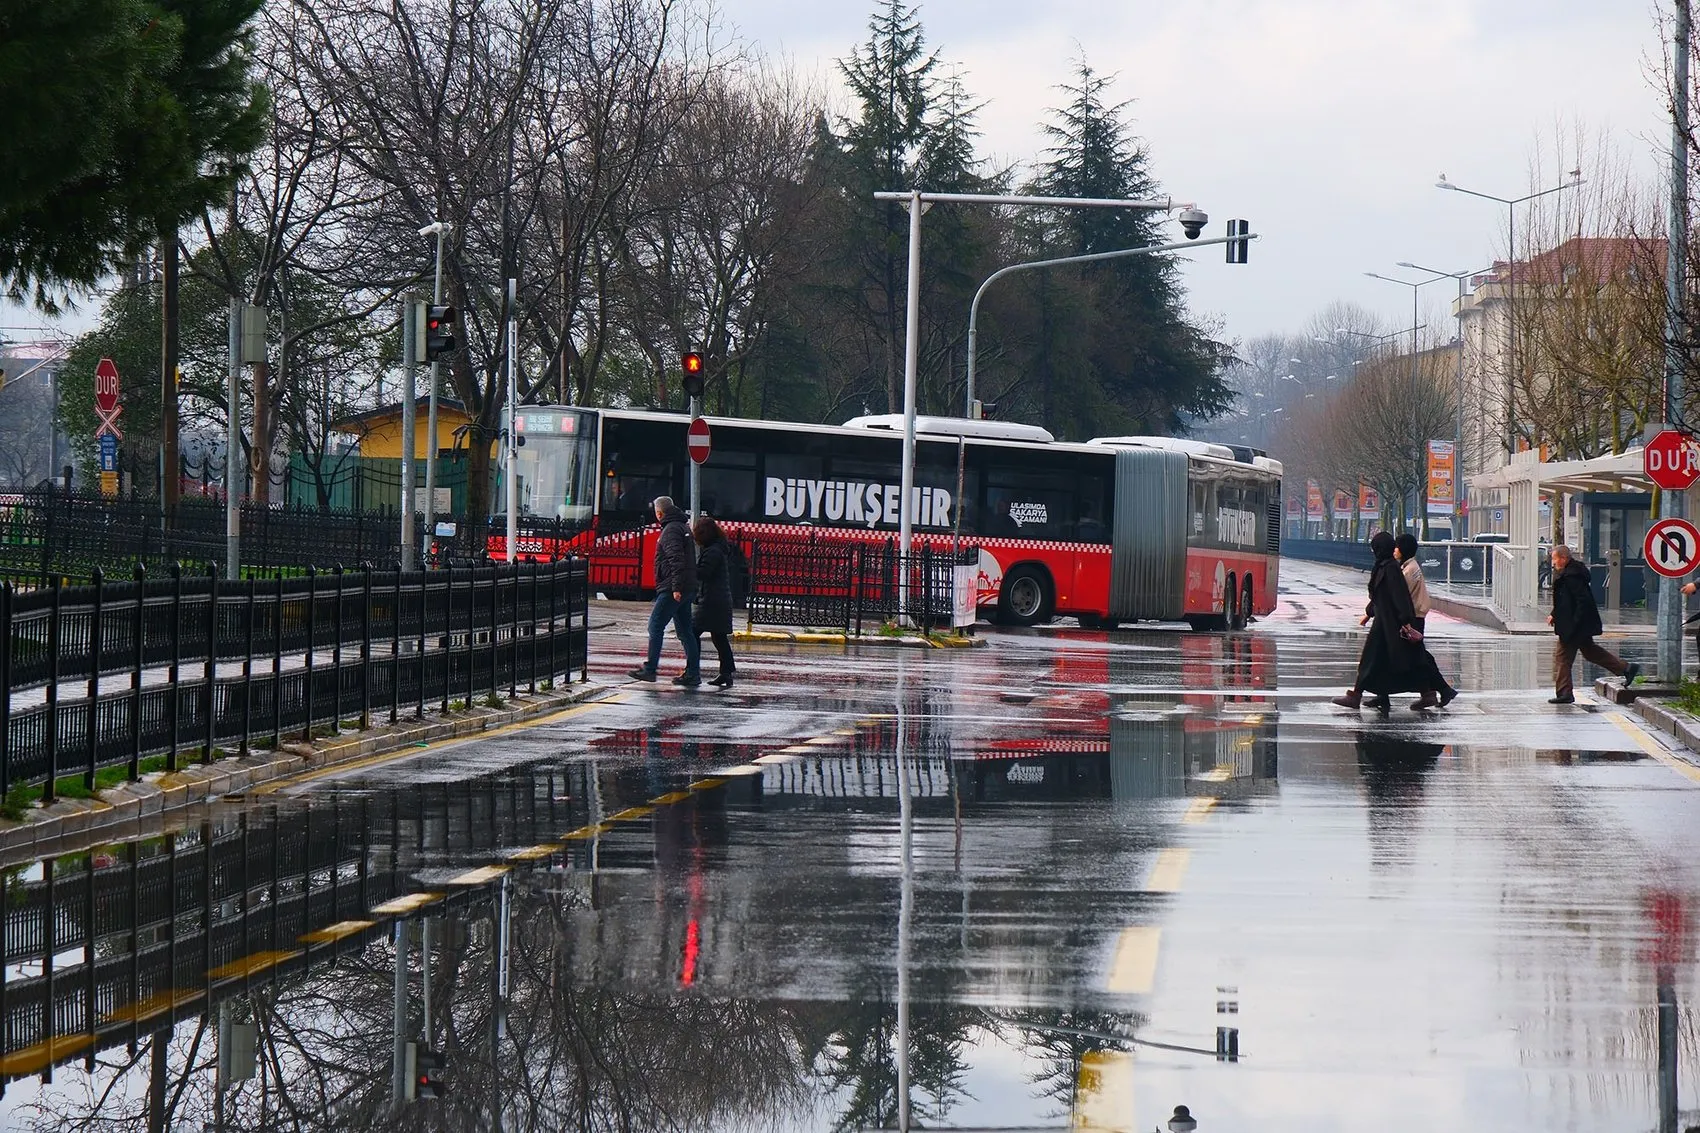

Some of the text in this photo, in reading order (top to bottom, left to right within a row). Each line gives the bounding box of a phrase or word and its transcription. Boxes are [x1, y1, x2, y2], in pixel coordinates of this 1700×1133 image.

[97, 376, 117, 395] DUR
[1650, 449, 1698, 471] DUR
[1010, 509, 1047, 517] SAKARYA
